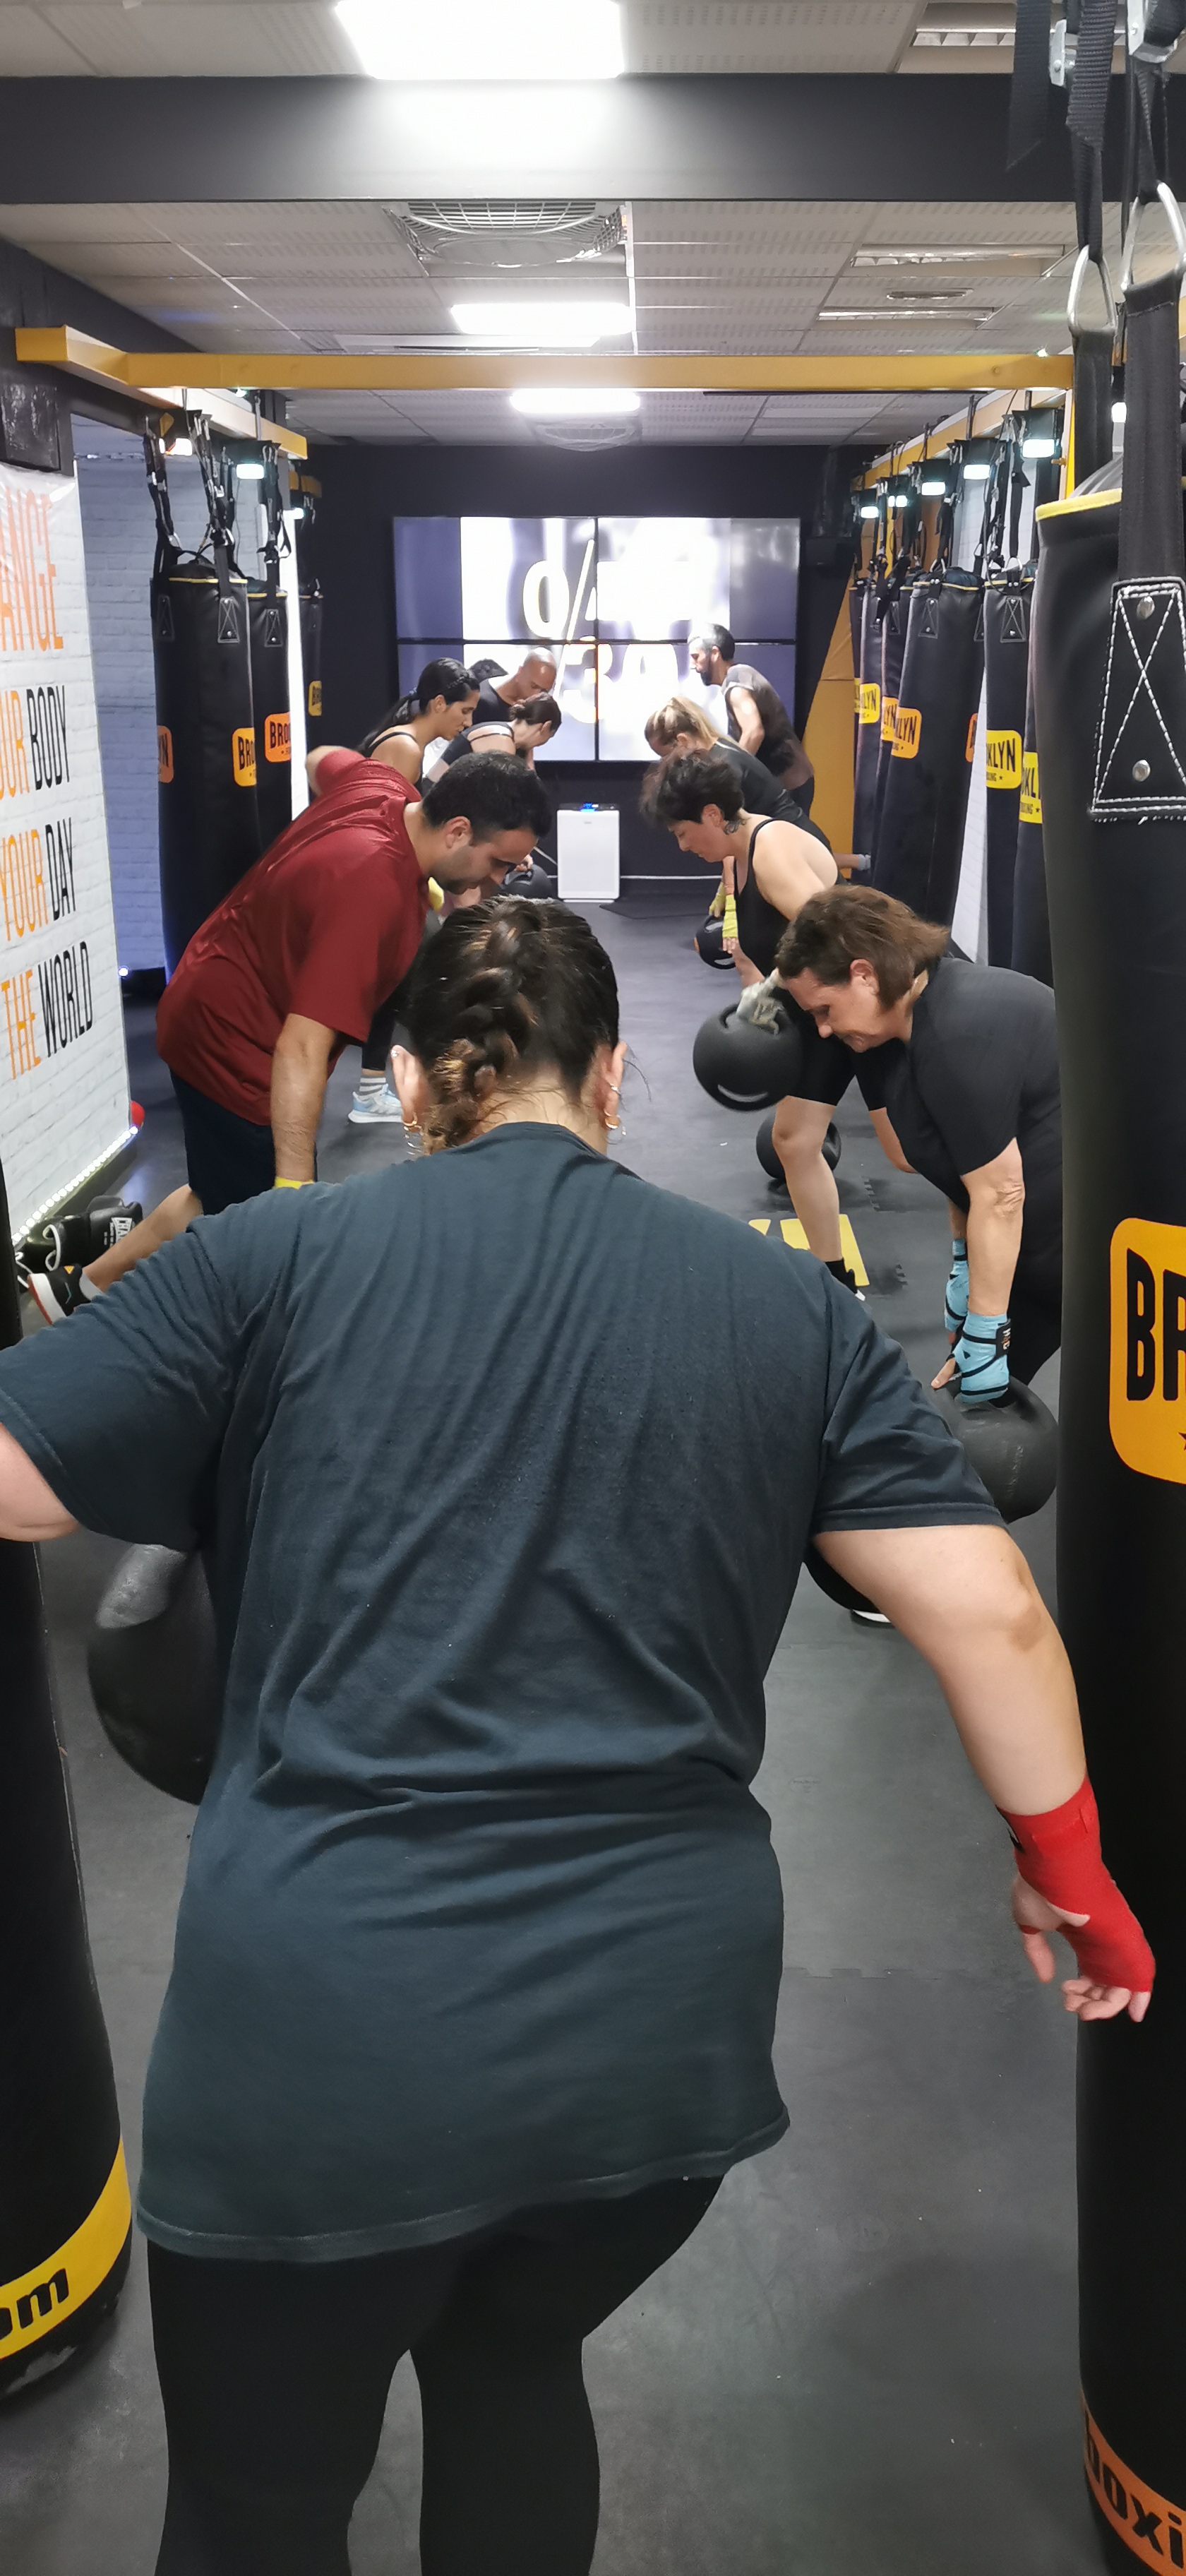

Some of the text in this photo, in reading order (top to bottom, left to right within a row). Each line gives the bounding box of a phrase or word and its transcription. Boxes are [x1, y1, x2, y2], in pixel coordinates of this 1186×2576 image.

[26, 685, 70, 790] BODY
[0, 816, 76, 941] YOUR DAY
[1, 941, 93, 1080] THE WORLD
